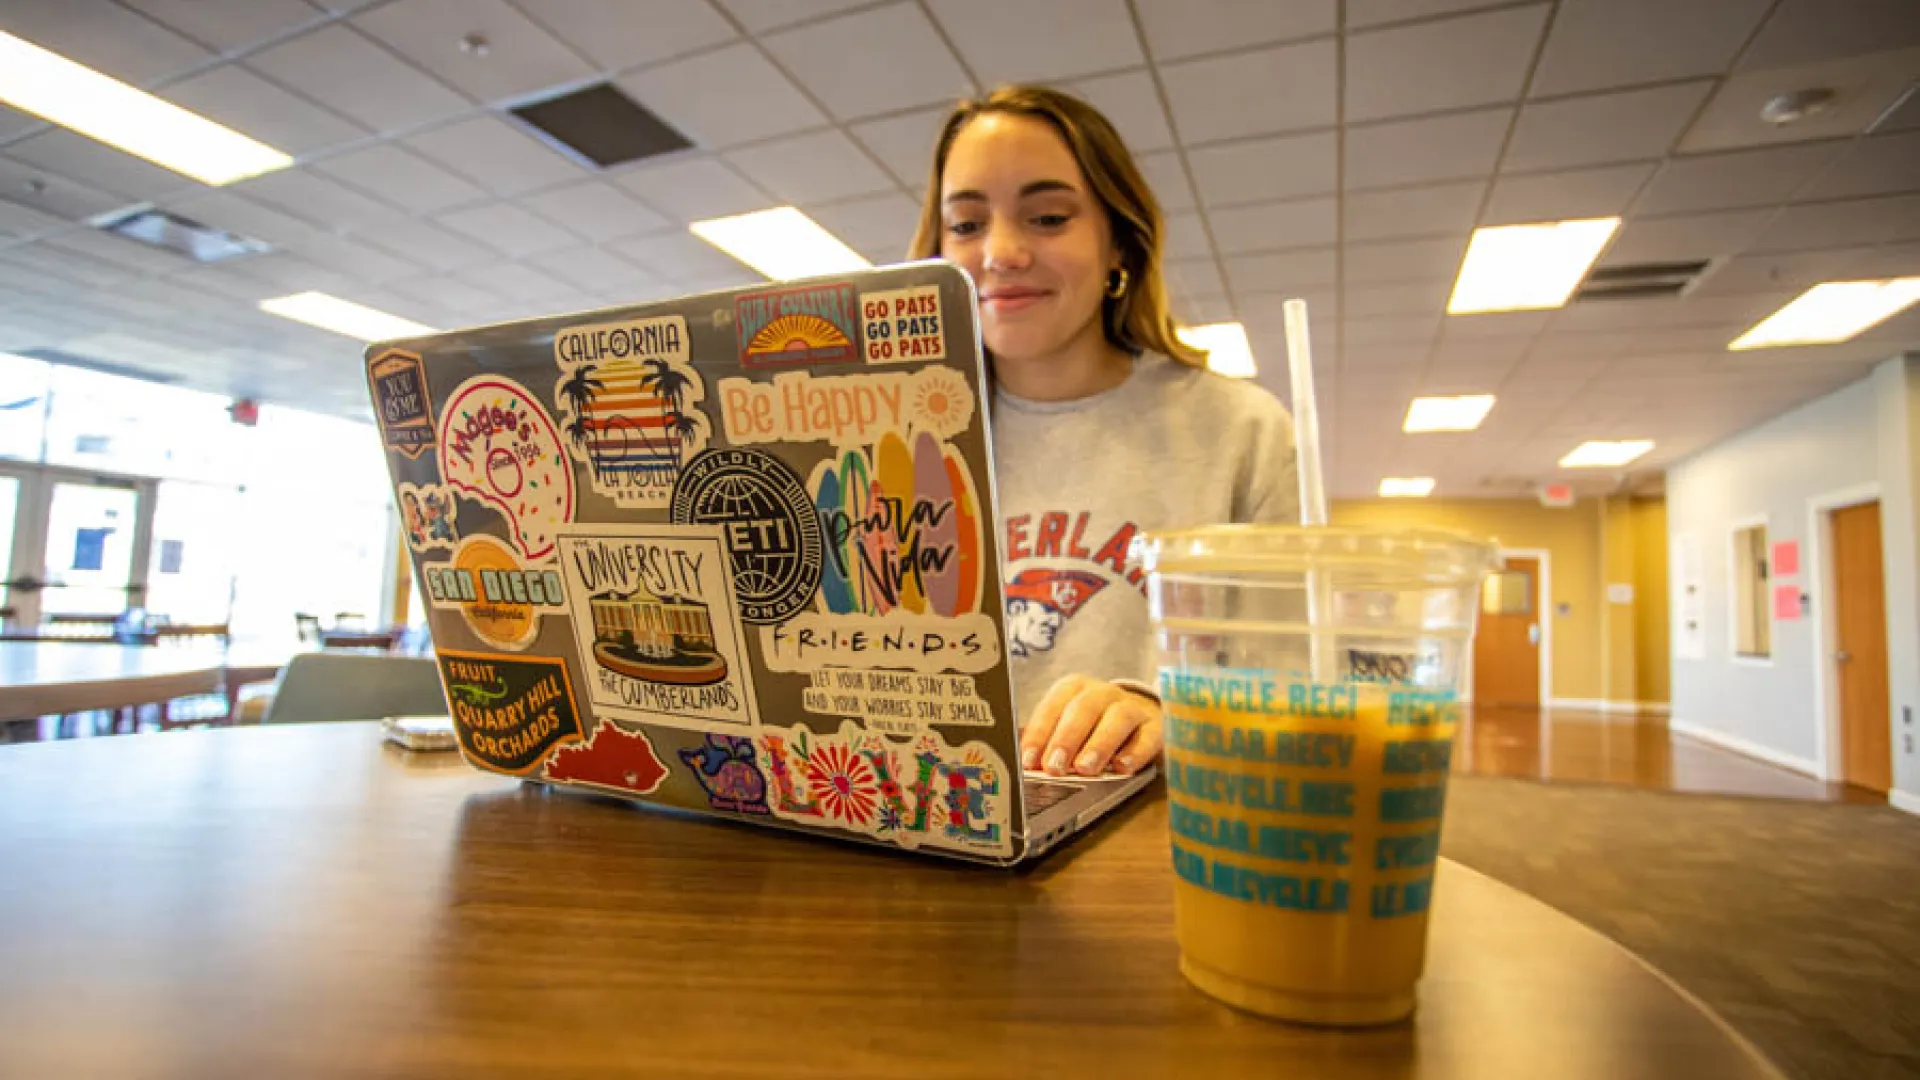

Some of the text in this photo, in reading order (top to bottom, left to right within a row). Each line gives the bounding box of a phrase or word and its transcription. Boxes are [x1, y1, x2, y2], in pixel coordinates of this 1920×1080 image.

[865, 295, 937, 319] GO PATS
[558, 323, 680, 362] CALIFORNIA
[867, 316, 939, 341] GO PATS
[869, 342, 892, 360] GO
[900, 337, 942, 358] PATS
[726, 387, 774, 436] Be
[694, 451, 772, 477] WILDLY
[728, 518, 789, 551] ETI
[573, 541, 703, 596] UNIVERSITY
[427, 567, 564, 606] SAN DIEGO
[740, 582, 811, 618] ONGER
[449, 662, 496, 683] FRUIT
[812, 670, 972, 697] LET YOUR DREAMS STAY BIG
[457, 674, 563, 731] QUARRY HILL
[620, 678, 739, 711] CUMBERLANDS
[806, 691, 992, 722] AND YOUR WORRIES STAY SMALL
[472, 706, 560, 758] ORCHARDS
